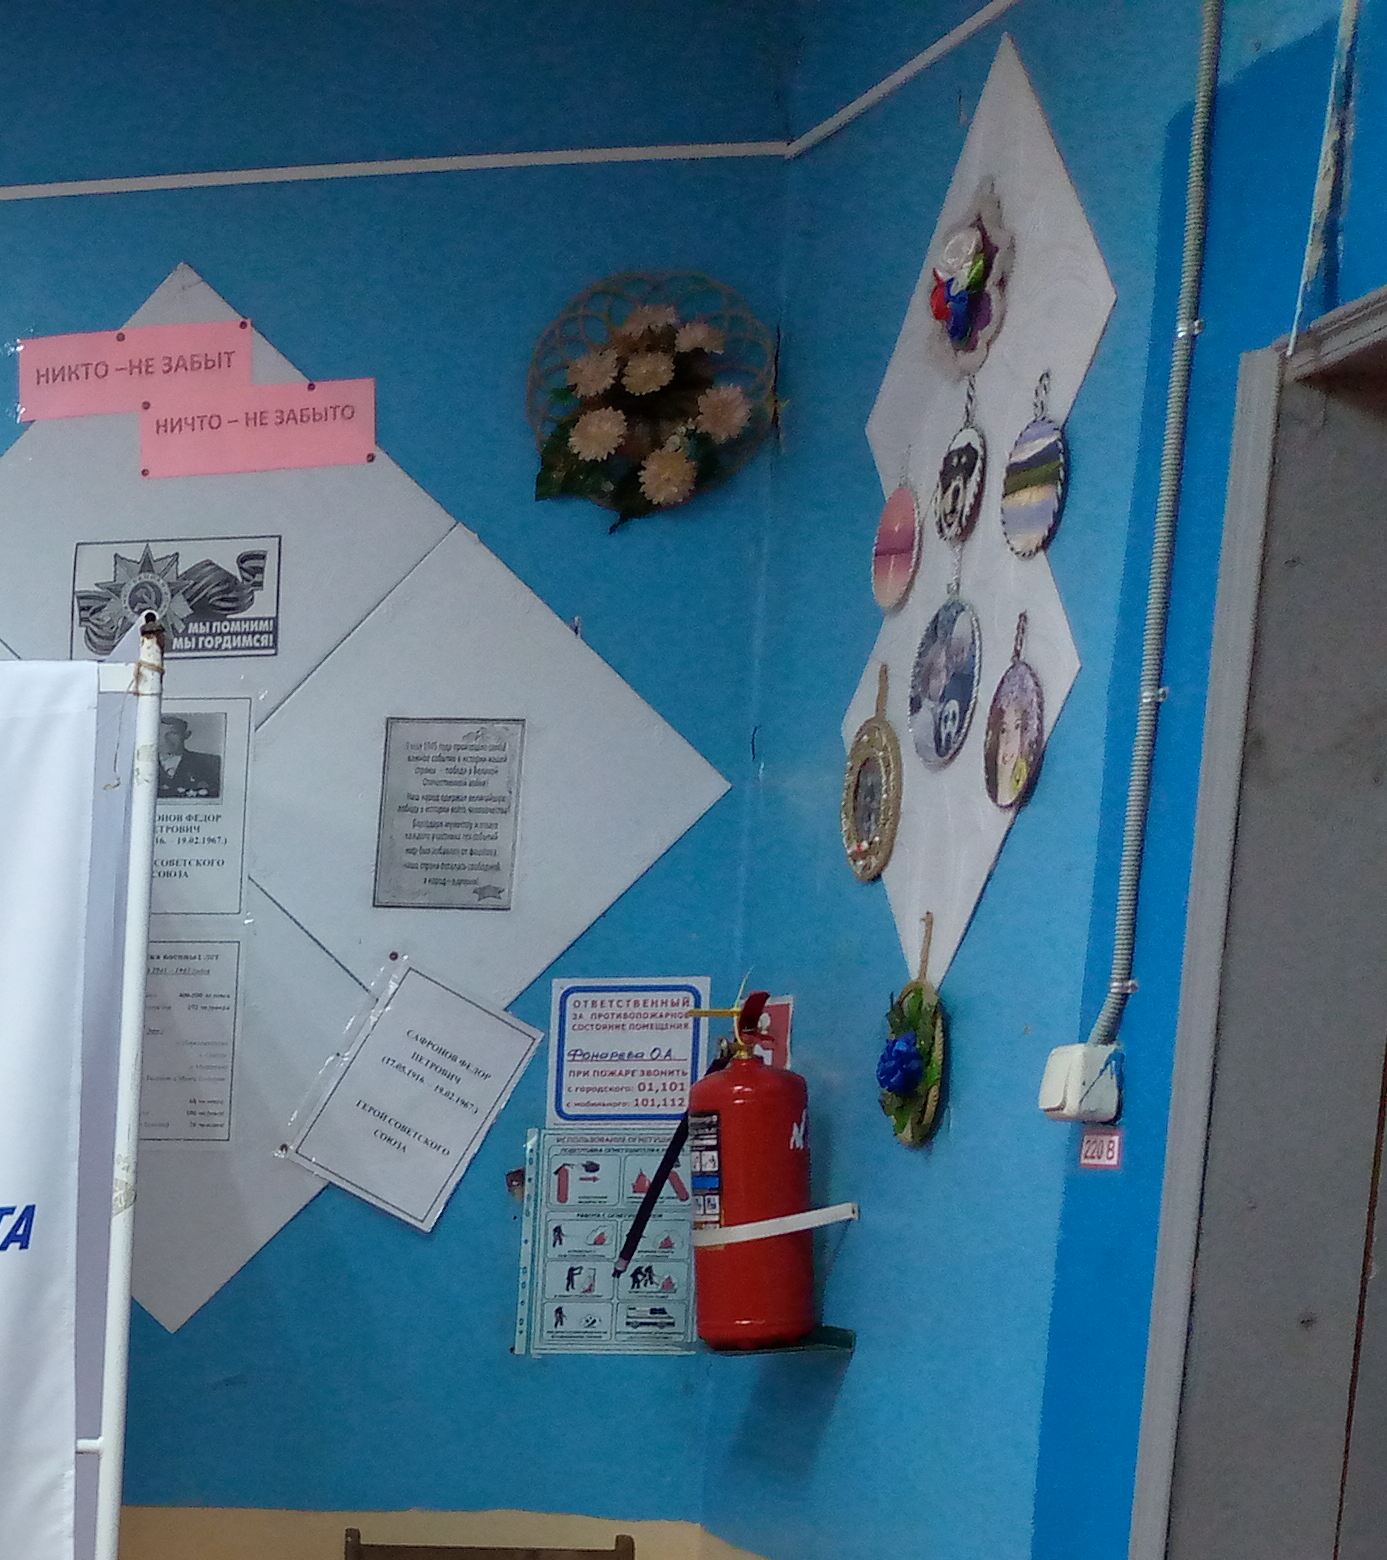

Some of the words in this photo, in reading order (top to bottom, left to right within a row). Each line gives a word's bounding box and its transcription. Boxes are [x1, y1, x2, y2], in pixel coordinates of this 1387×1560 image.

[35, 360, 109, 385] НИКТО
[162, 351, 236, 374] ЗАБЫТ
[156, 412, 222, 435] НИЧТО
[245, 411, 269, 427] НЕ
[275, 404, 355, 425] ЗАБЫТО
[188, 622, 209, 634] МЫ
[213, 620, 273, 632] ПОМНИМ!
[173, 637, 195, 649] МЫ
[198, 634, 274, 648] ГОРДИМСЯ!
[573, 996, 690, 1008] ОТВЕТСТВЕННЫЙ
[629, 1023, 689, 1031] ПОМЕЩЕНИЯ
[568, 1070, 589, 1078] ПРИ
[593, 1070, 635, 1078] ПОЖАРЕ
[639, 1069, 688, 1077] ЗВОНИТЬ
[637, 1082, 686, 1094] 01,101
[634, 1098, 686, 1109] 101,112
